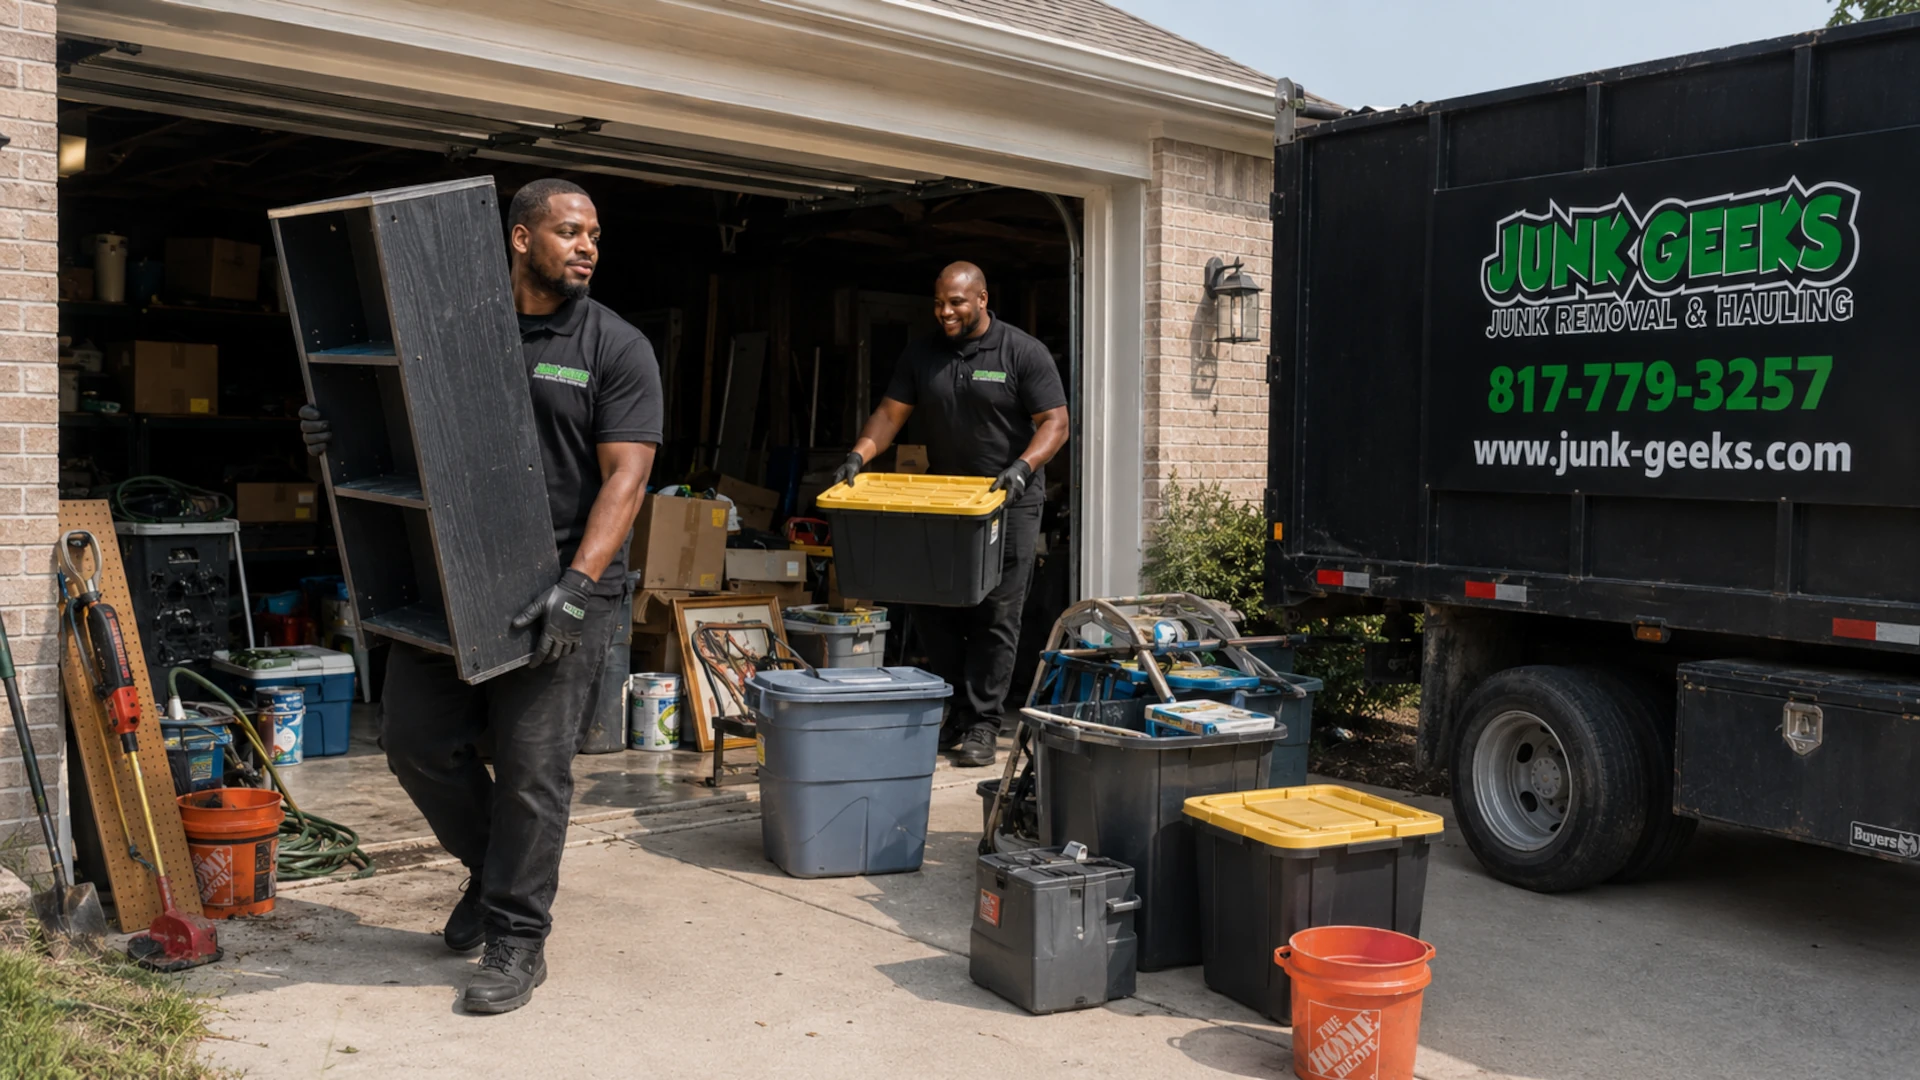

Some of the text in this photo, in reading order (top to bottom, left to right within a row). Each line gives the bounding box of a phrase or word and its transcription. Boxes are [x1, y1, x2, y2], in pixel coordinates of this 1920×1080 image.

[1487, 193, 1844, 294] JUNK GEEKS
[1485, 287, 1855, 339] JUNK REMOVAL & HAULING
[1487, 355, 1834, 414] 817-779-3257
[1473, 430, 1852, 479] www.junk-geeks.com
[1853, 826, 1898, 849] Buyers
[1308, 1009, 1380, 1075] HOME
